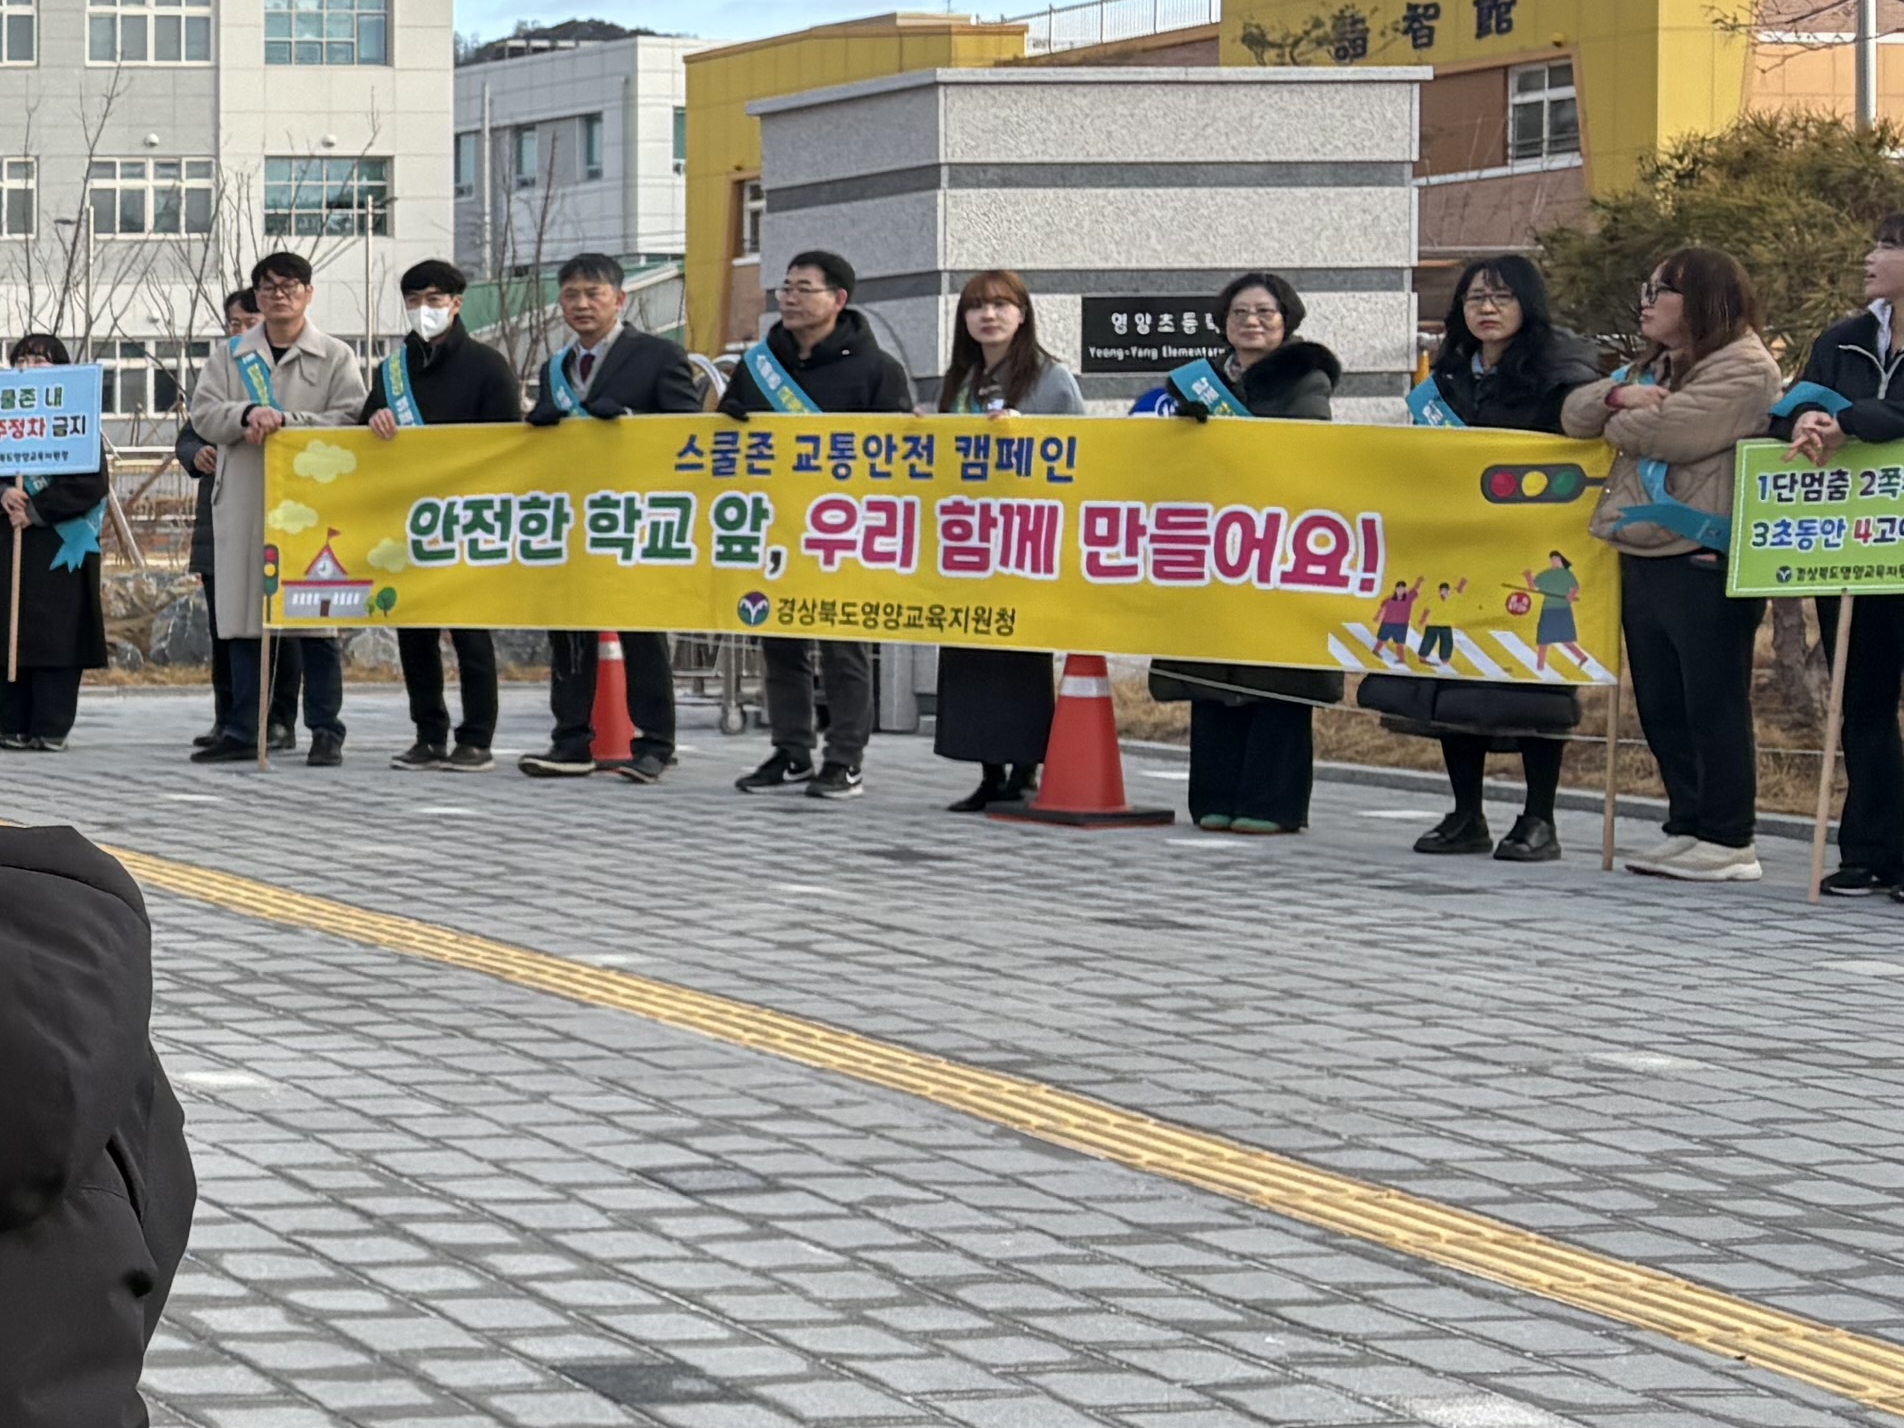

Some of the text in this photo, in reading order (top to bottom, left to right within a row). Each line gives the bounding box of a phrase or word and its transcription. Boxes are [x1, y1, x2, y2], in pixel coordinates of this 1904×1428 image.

[45, 386, 64, 408] 내
[52, 414, 86, 438] 금지
[674, 430, 1078, 485] 스쿨존 교통안전 캠페인
[1757, 466, 1904, 503] 1단멈춤 2쪽
[409, 493, 1380, 593] 안전한 학교 앞, 우리 함께 만들어요!
[1751, 518, 1847, 551] 3초동안
[776, 596, 1017, 636] 경상북도영양교육지원청
